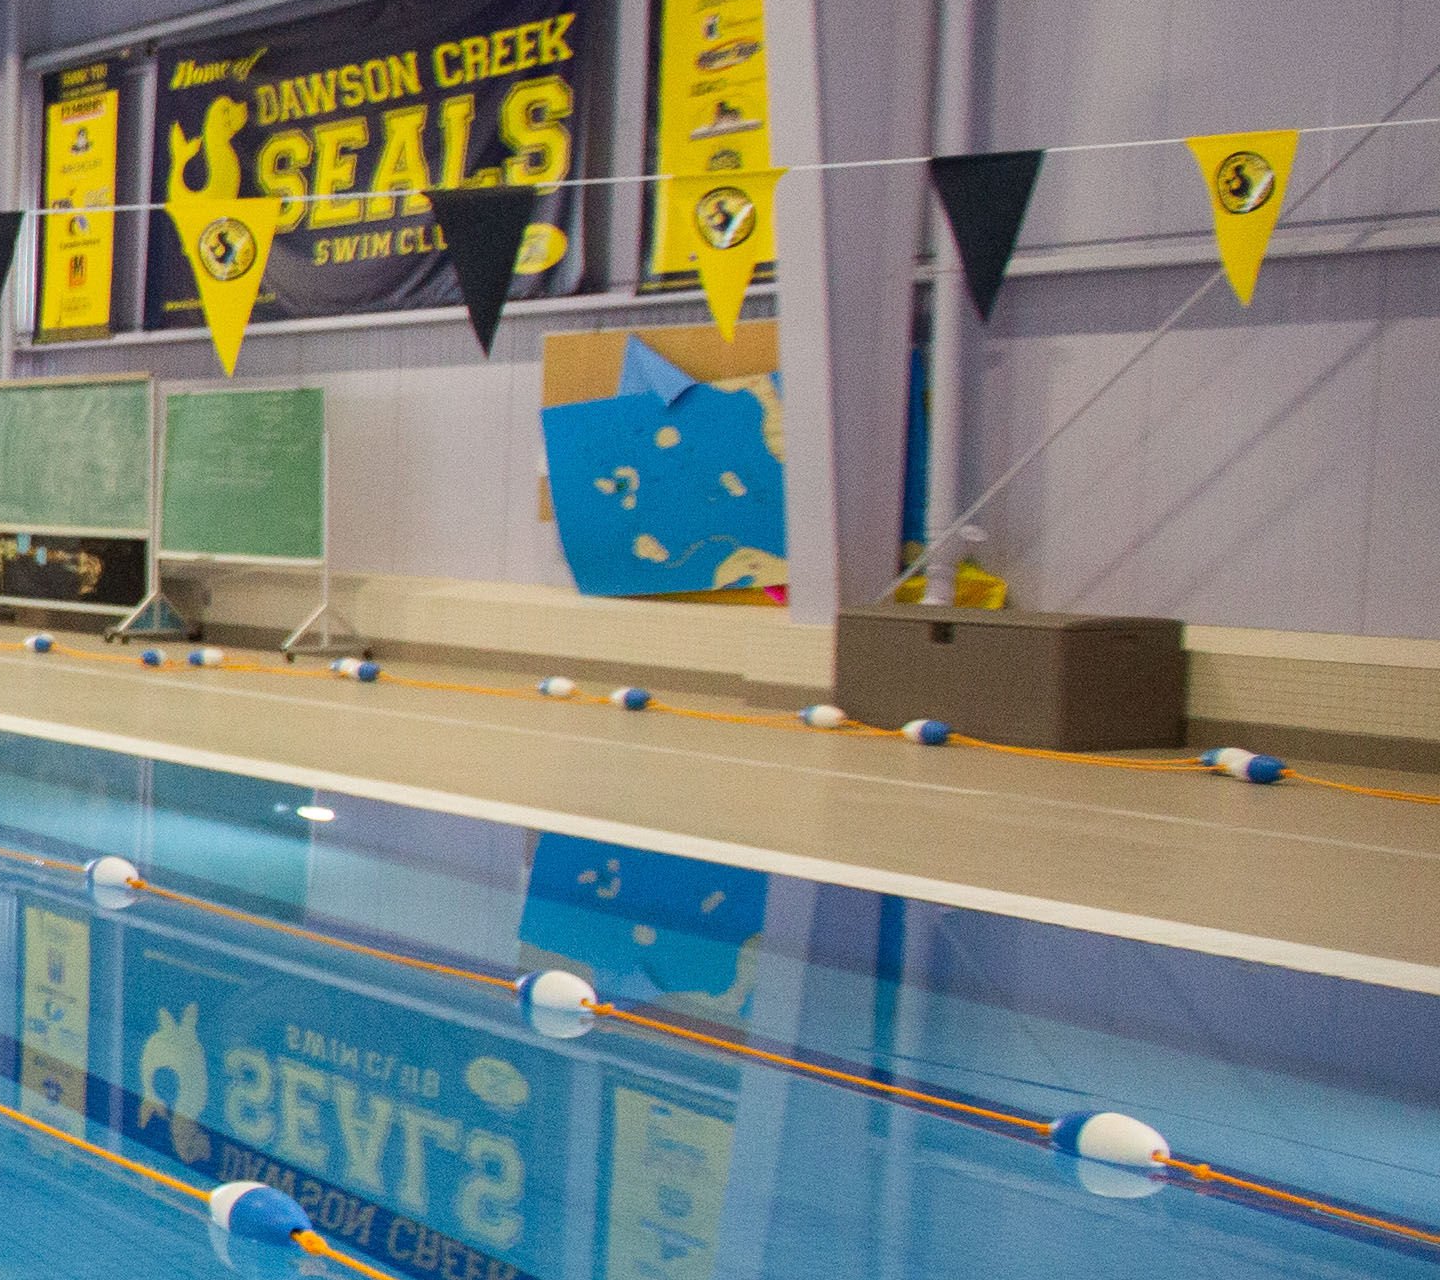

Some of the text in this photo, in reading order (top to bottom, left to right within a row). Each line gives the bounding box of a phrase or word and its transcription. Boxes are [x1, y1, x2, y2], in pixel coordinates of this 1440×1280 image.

[169, 46, 269, 90] Home of
[255, 12, 578, 127] DAWSON CREEK
[257, 74, 575, 234] SEALS
[312, 223, 449, 267] SWIM CLU
